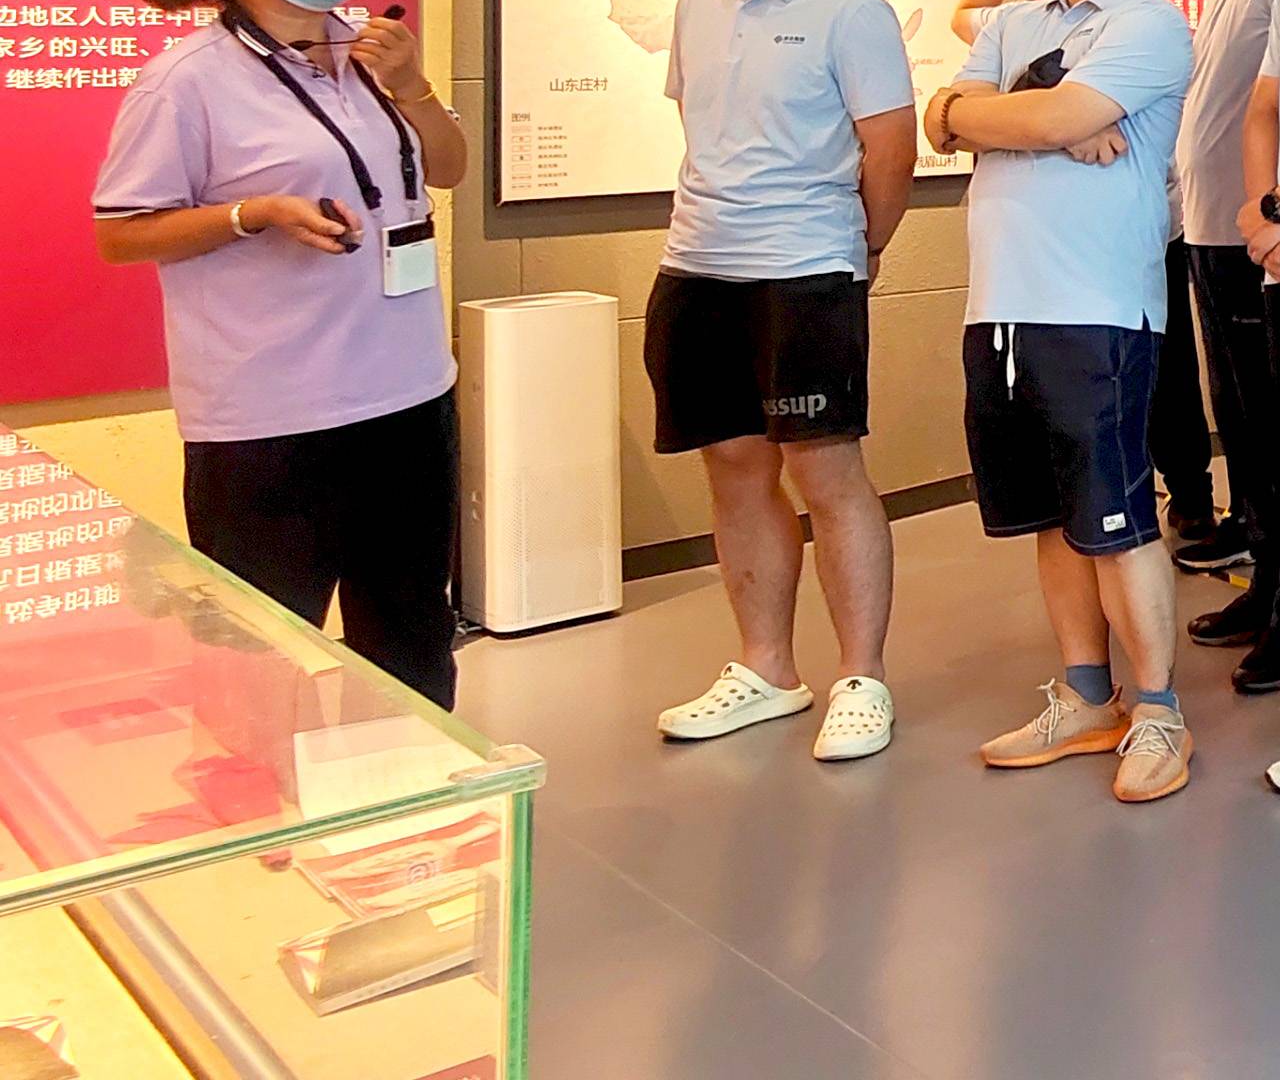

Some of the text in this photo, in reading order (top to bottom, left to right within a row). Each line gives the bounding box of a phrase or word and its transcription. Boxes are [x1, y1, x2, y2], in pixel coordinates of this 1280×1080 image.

[548, 77, 609, 93] 山东庄村
[762, 393, 827, 419] ssup
